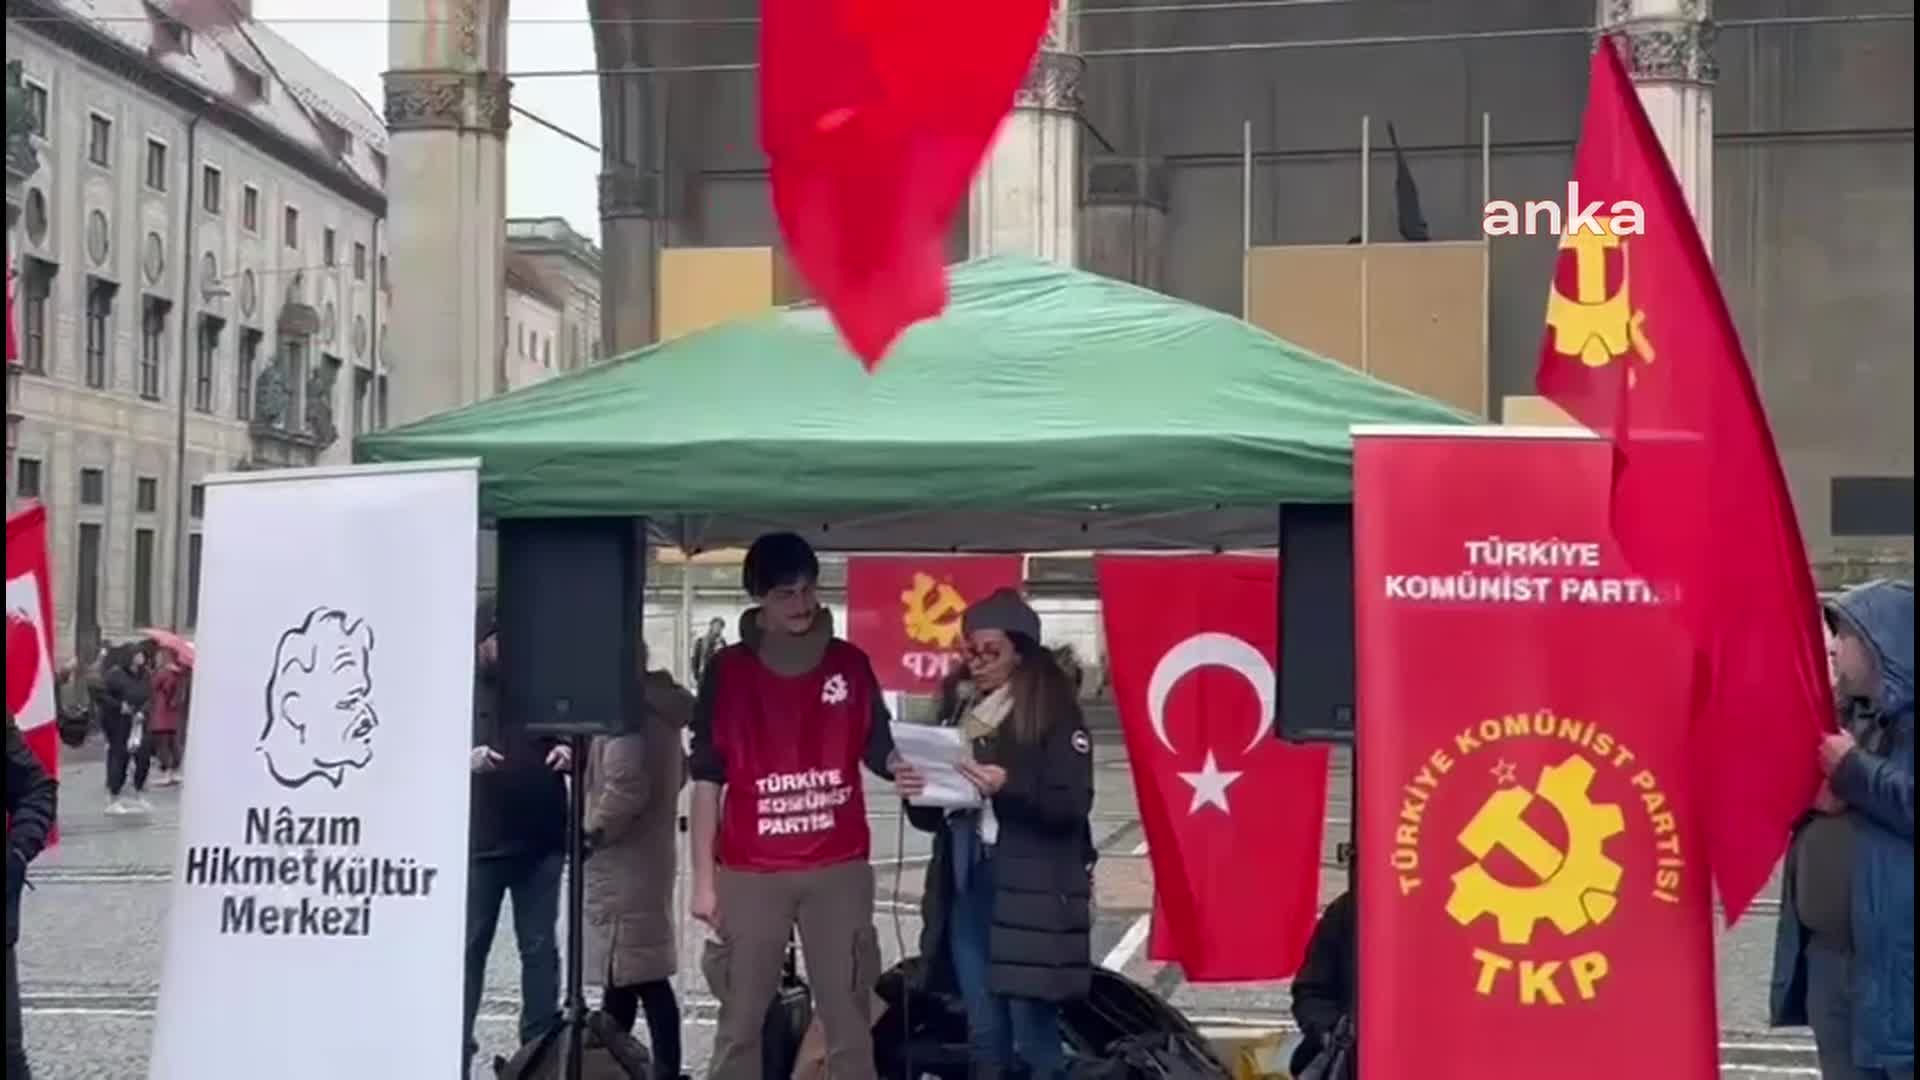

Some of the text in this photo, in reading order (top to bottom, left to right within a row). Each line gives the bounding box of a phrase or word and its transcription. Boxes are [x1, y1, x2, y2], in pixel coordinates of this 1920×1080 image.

[1464, 536, 1600, 567] TÜRKİYE
[1385, 571, 1682, 603] KOMÜNİST PARTİ
[755, 767, 844, 794] TÜRKİYE
[1391, 748, 1454, 895] TÜRKİYE
[1454, 708, 1635, 768] KOMÜNİST
[245, 806, 361, 846] Nâzım
[186, 846, 437, 897] Hikmet Kültür
[220, 896, 372, 936] Merkezi
[1472, 948, 1609, 1005] TKP
